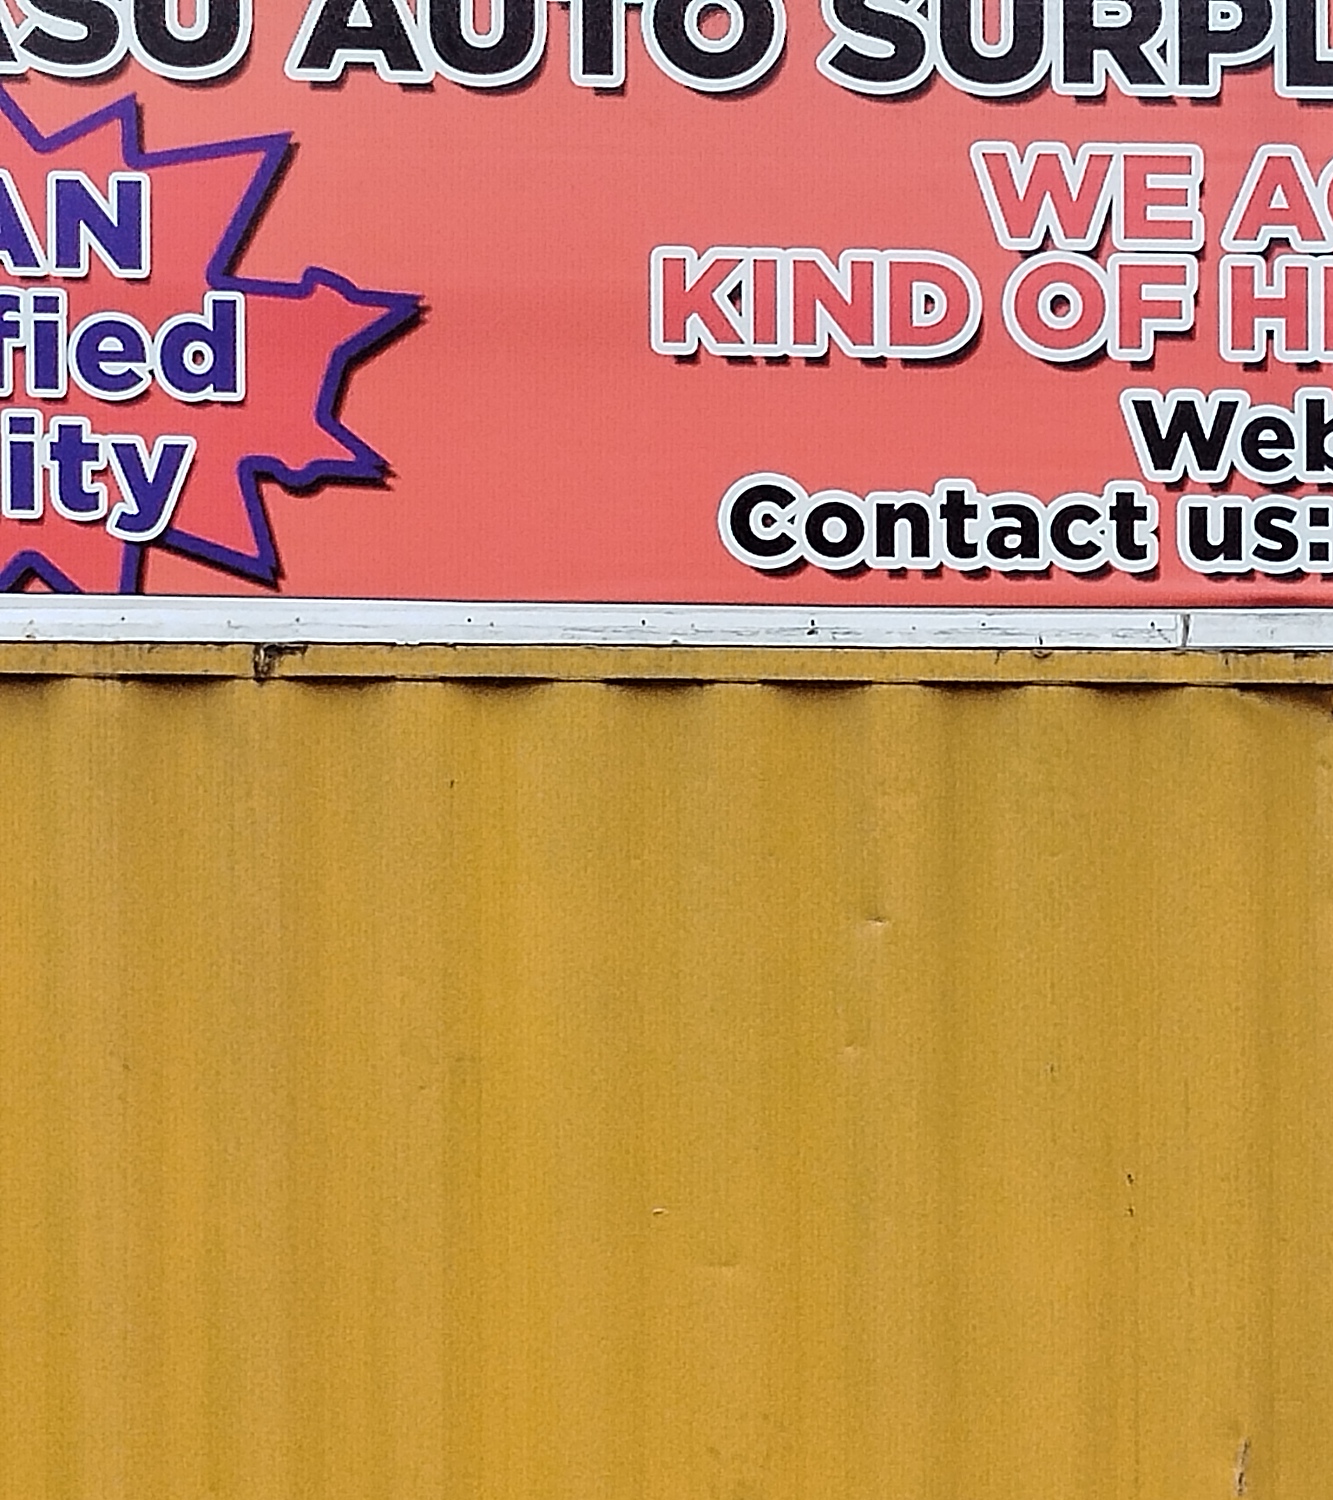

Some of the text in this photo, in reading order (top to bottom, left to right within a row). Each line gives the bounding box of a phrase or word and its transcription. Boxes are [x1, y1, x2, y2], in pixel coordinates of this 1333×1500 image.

[0, 0, 253, 80] SU
[285, 0, 787, 93] AUTO
[972, 142, 1203, 251] WE
[651, 247, 981, 360] KIND
[1003, 251, 1199, 363] OF
[717, 471, 1158, 573] Contact
